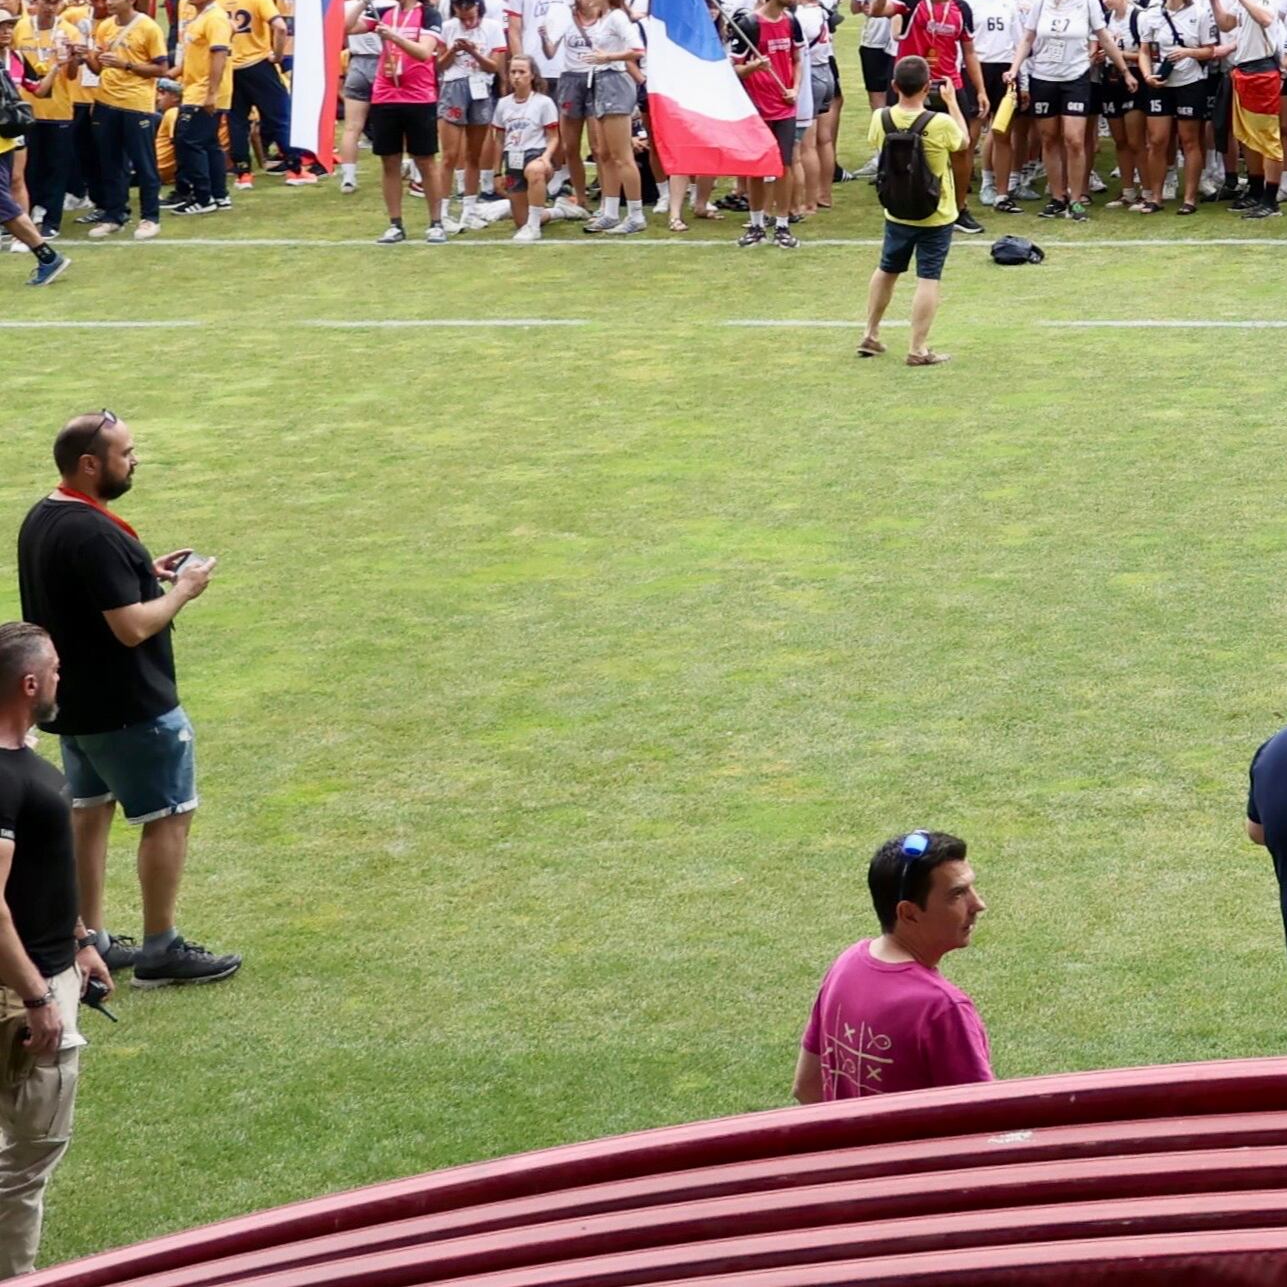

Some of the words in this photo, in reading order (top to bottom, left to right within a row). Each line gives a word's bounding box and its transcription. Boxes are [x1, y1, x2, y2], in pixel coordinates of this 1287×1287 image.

[987, 17, 1005, 32] 65
[1034, 102, 1050, 114] 97
[1150, 99, 1162, 112] 15
